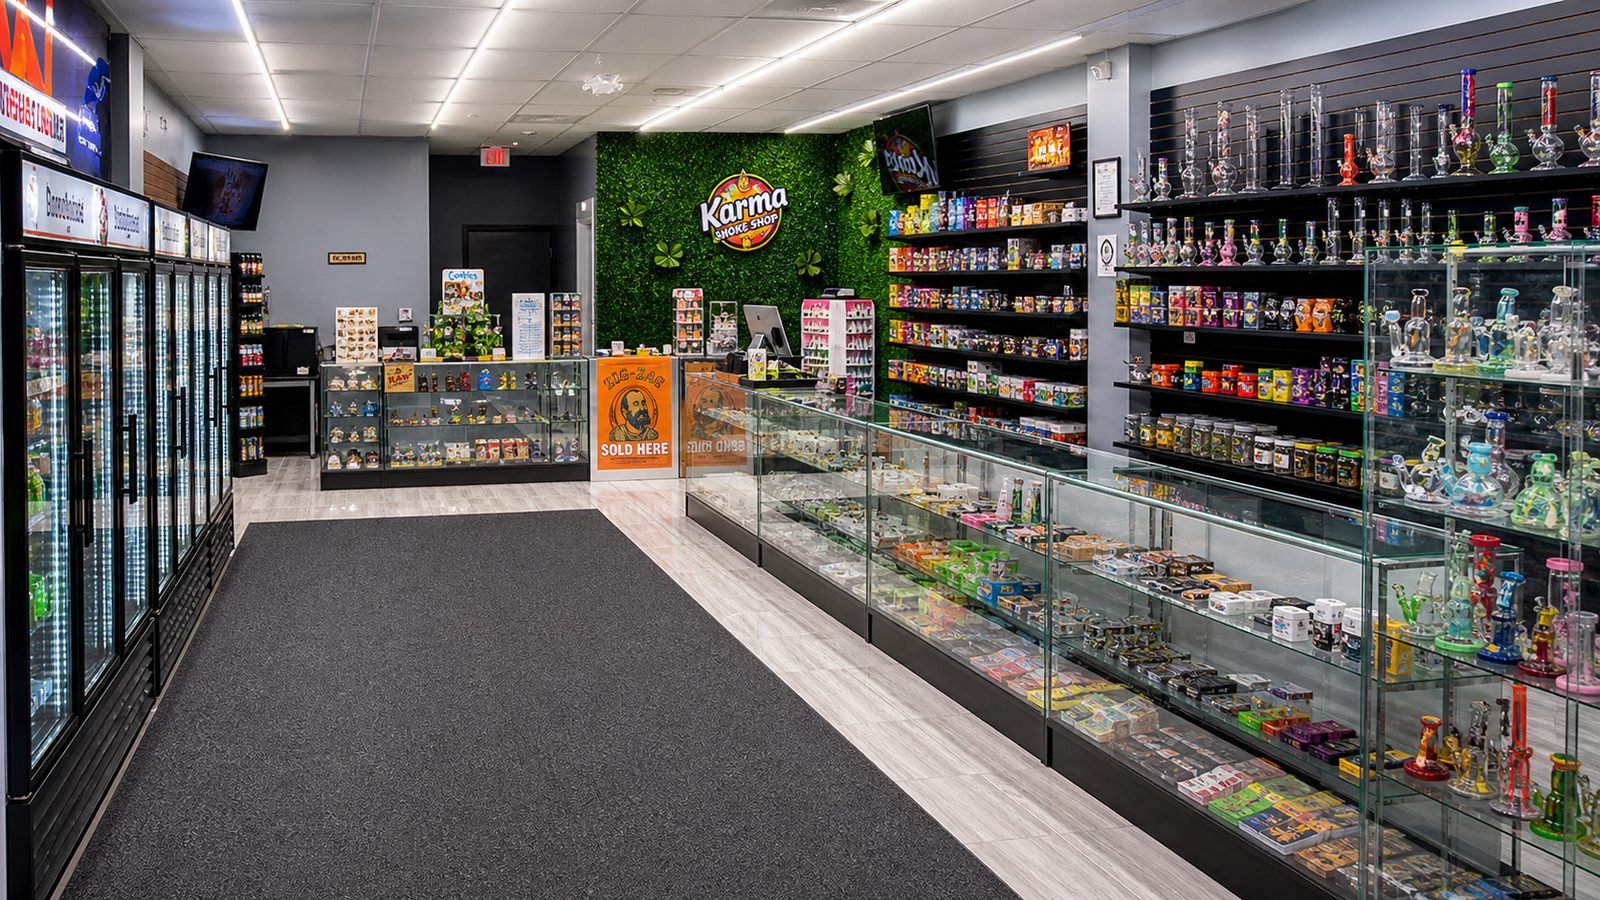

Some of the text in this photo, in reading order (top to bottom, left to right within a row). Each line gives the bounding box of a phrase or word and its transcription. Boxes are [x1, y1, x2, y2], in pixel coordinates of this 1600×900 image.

[700, 188, 788, 232] Karma
[750, 213, 778, 229] SHOP
[601, 443, 633, 456] SOLD
[637, 442, 669, 456] HERE
